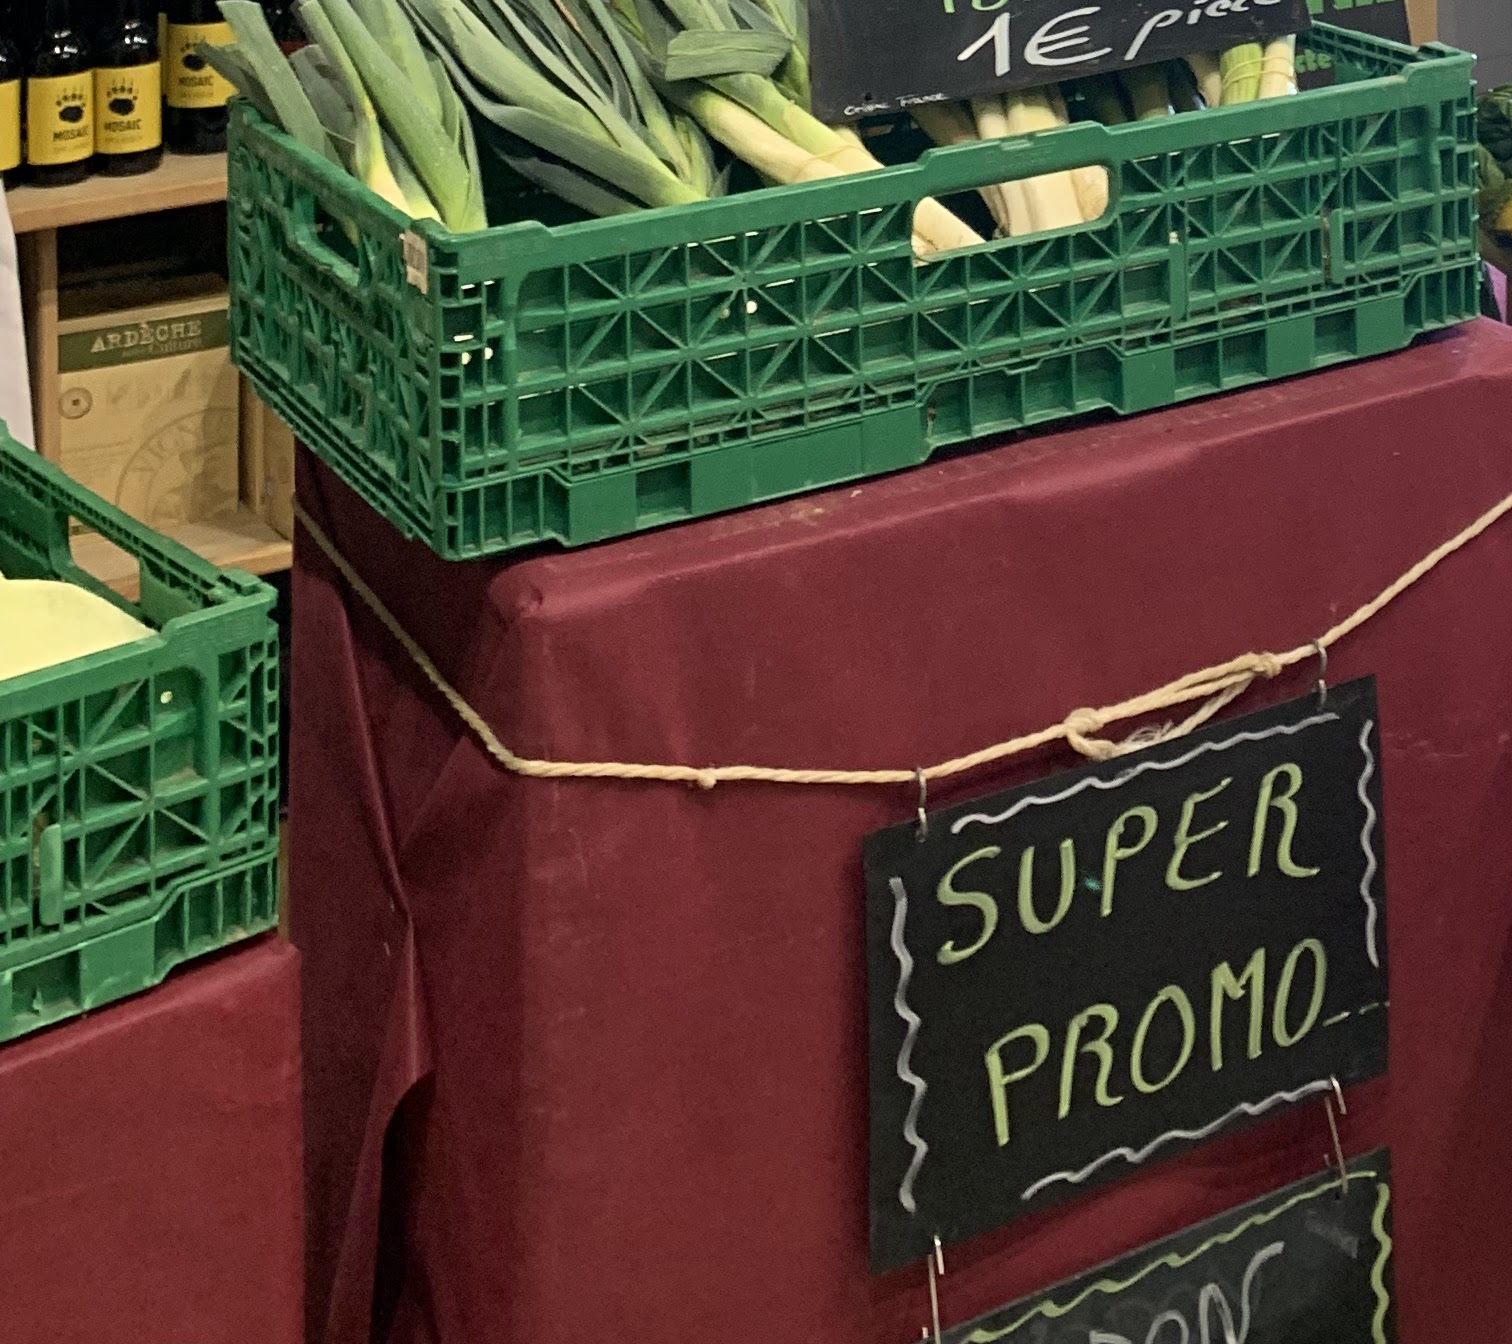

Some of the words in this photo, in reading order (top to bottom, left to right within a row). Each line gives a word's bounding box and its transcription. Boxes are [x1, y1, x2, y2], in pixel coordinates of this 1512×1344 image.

[957, 7, 1113, 78] 1€
[178, 75, 215, 88] MOSAIC
[103, 118, 143, 133] MOSAIC
[90, 319, 203, 354] ARDÈCHE
[936, 762, 1321, 966] SUPER
[985, 937, 1328, 1147] PROMO
